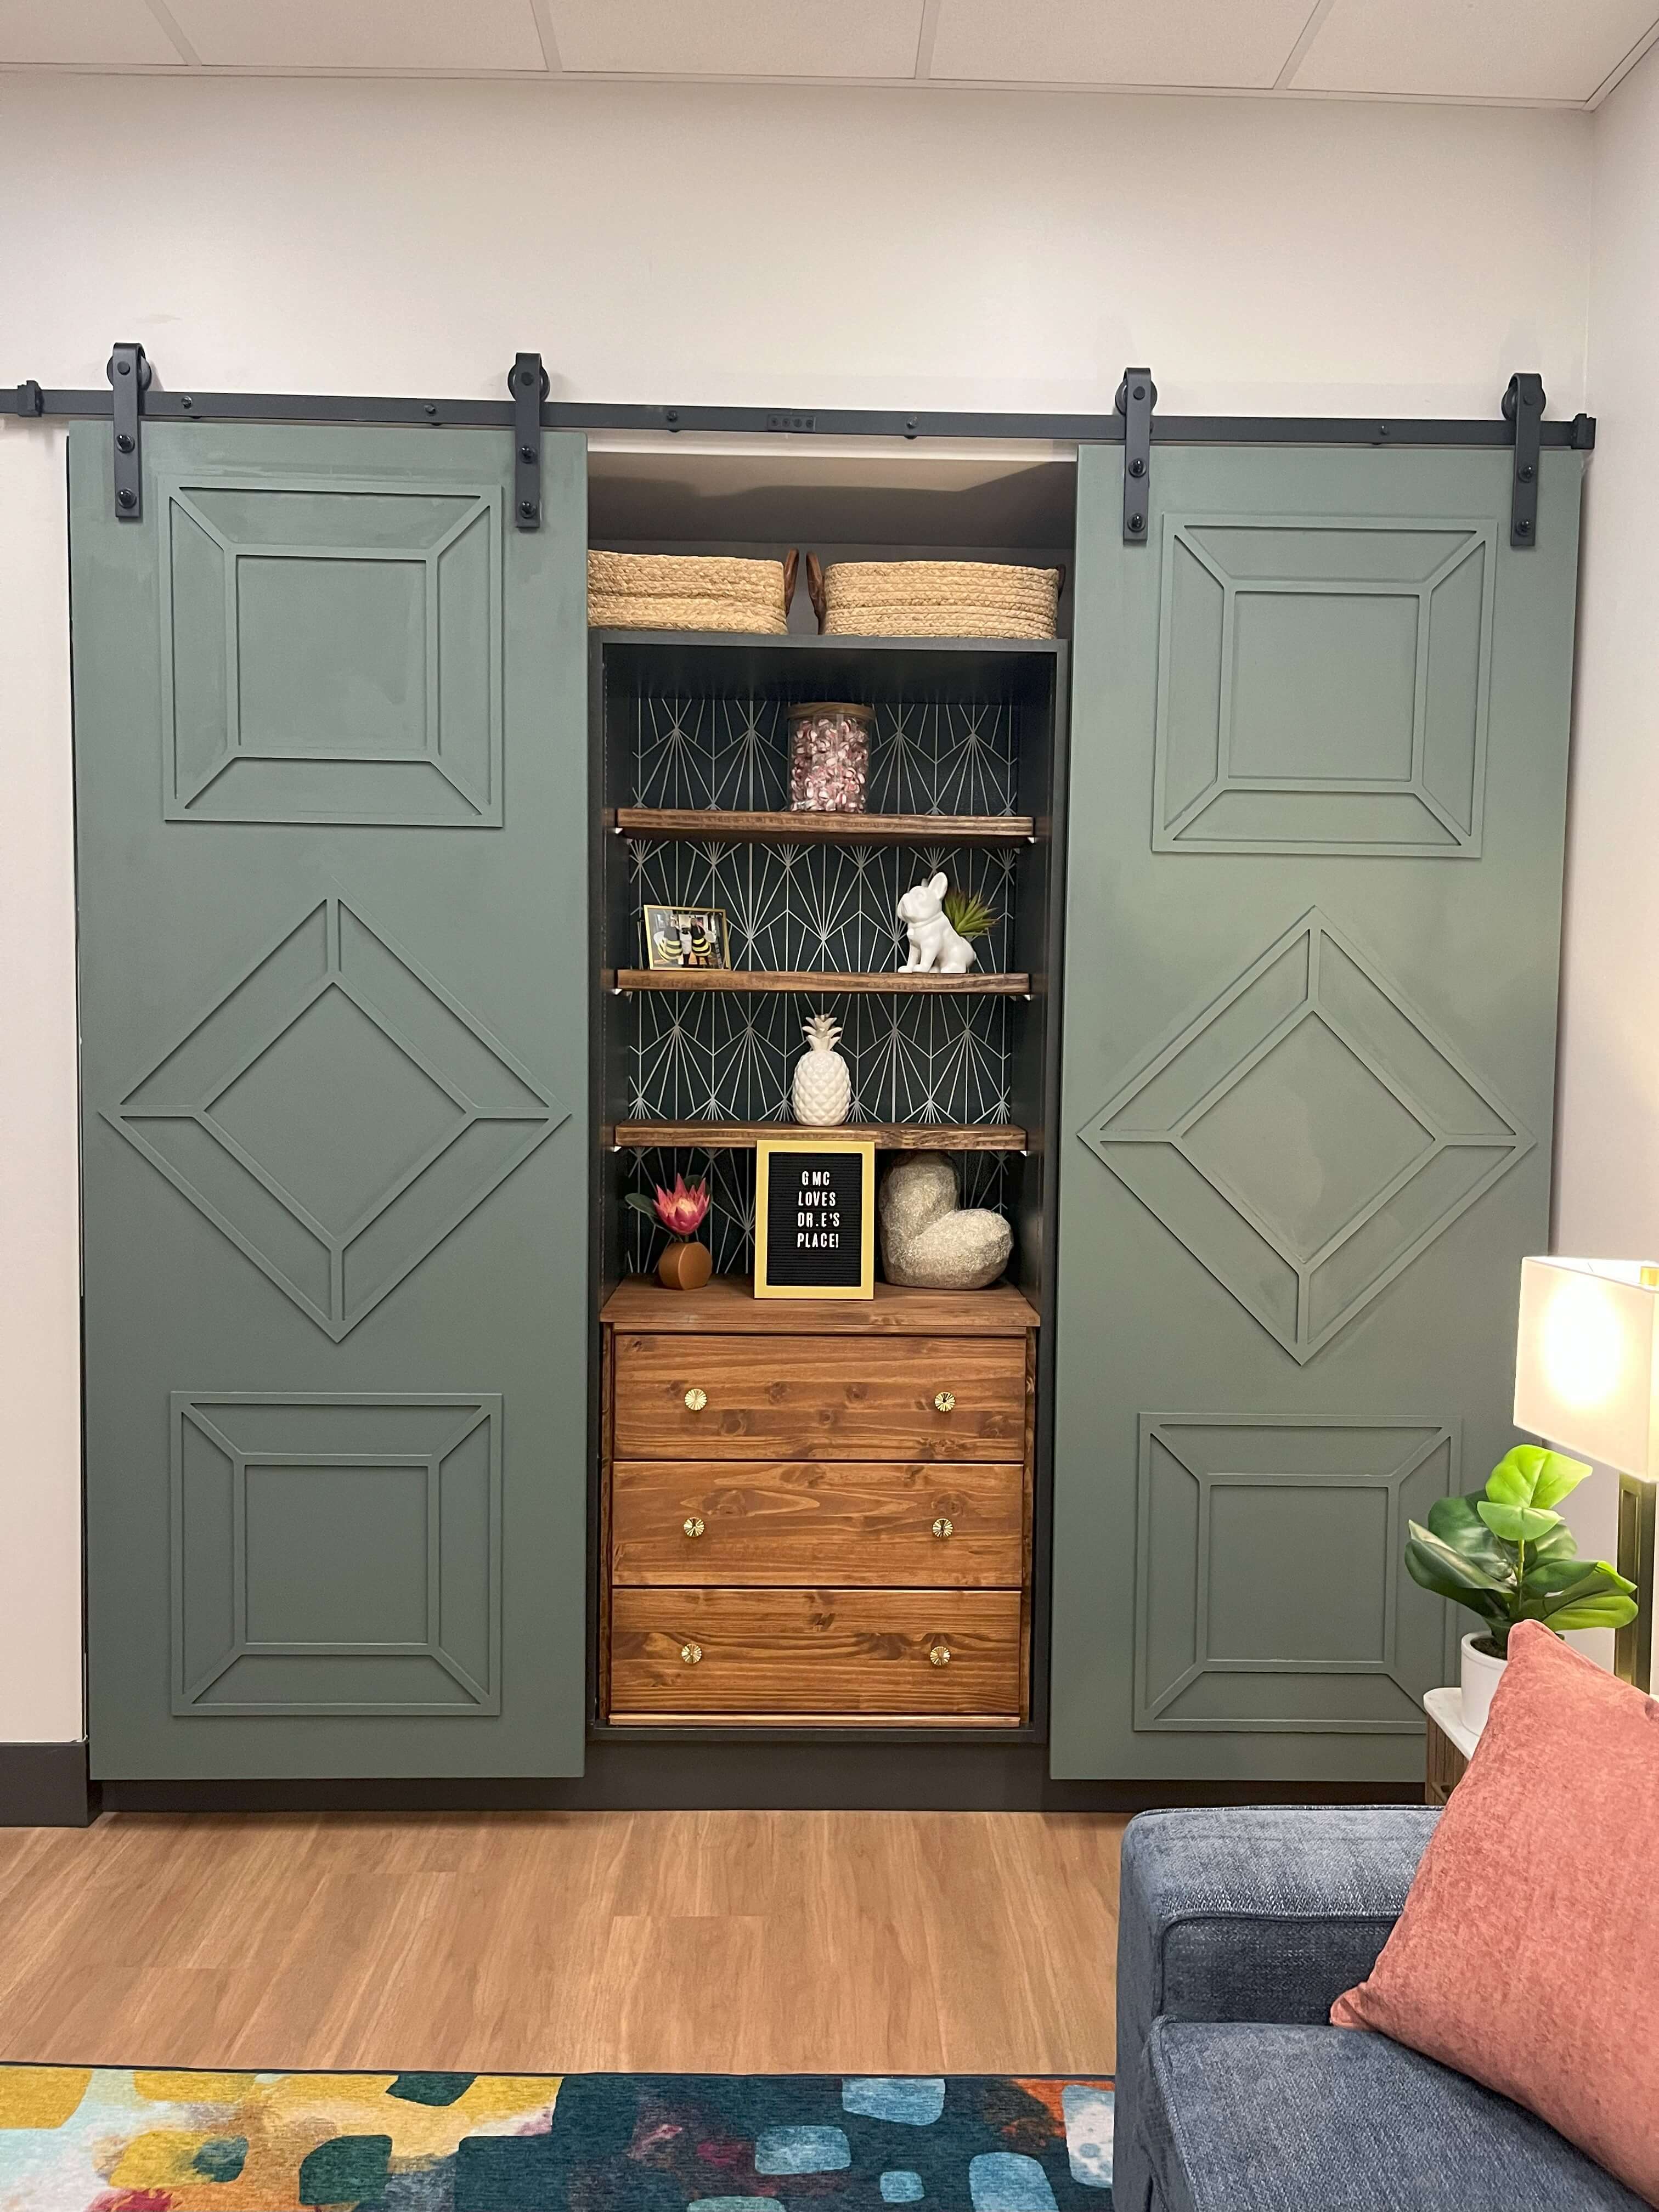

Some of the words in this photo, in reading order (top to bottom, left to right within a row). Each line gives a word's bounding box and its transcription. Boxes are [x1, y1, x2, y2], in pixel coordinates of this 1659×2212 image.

[802, 1171, 830, 1187] GMC
[798, 1190, 836, 1206] LOVES
[797, 1233, 839, 1248] PLACE!
